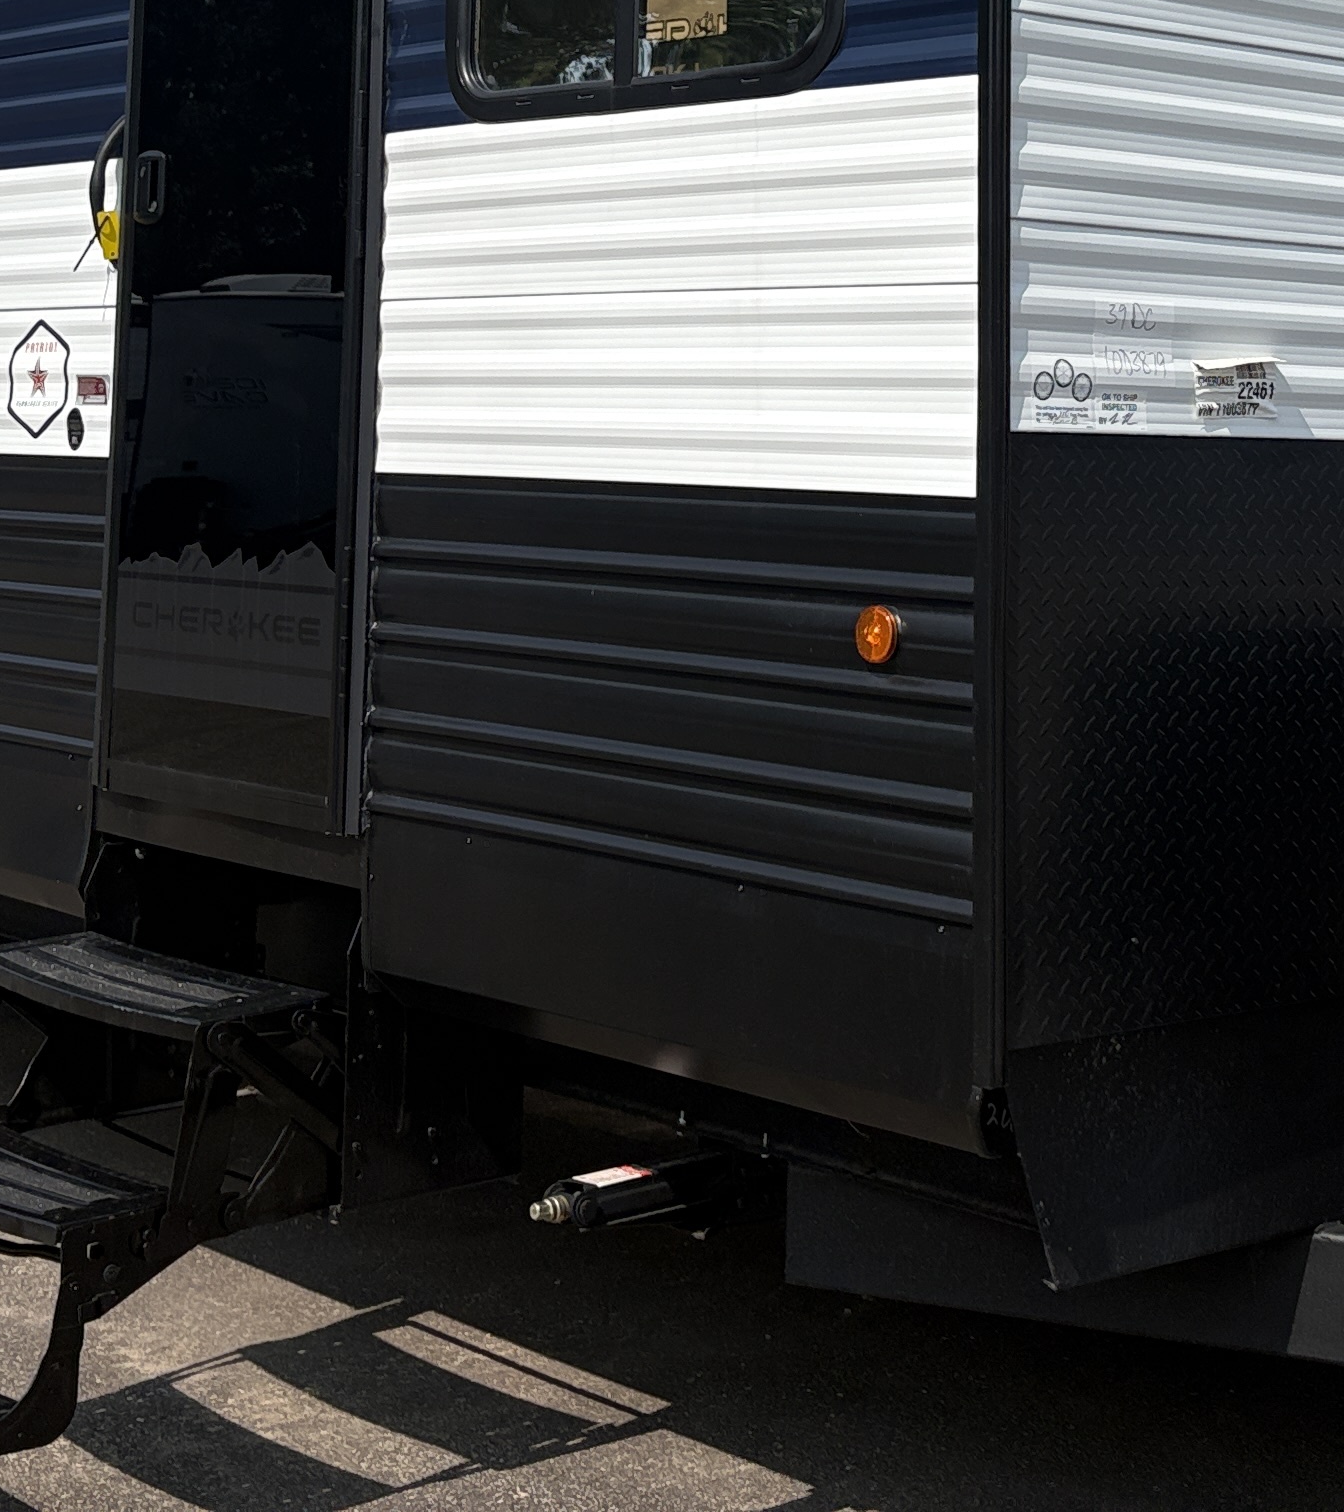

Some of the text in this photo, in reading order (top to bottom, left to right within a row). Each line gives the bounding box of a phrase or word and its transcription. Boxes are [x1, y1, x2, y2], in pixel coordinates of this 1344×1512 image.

[1237, 381, 1275, 400] 22461
[1113, 393, 1123, 401] TO
[1101, 403, 1138, 412] INSPECTED
